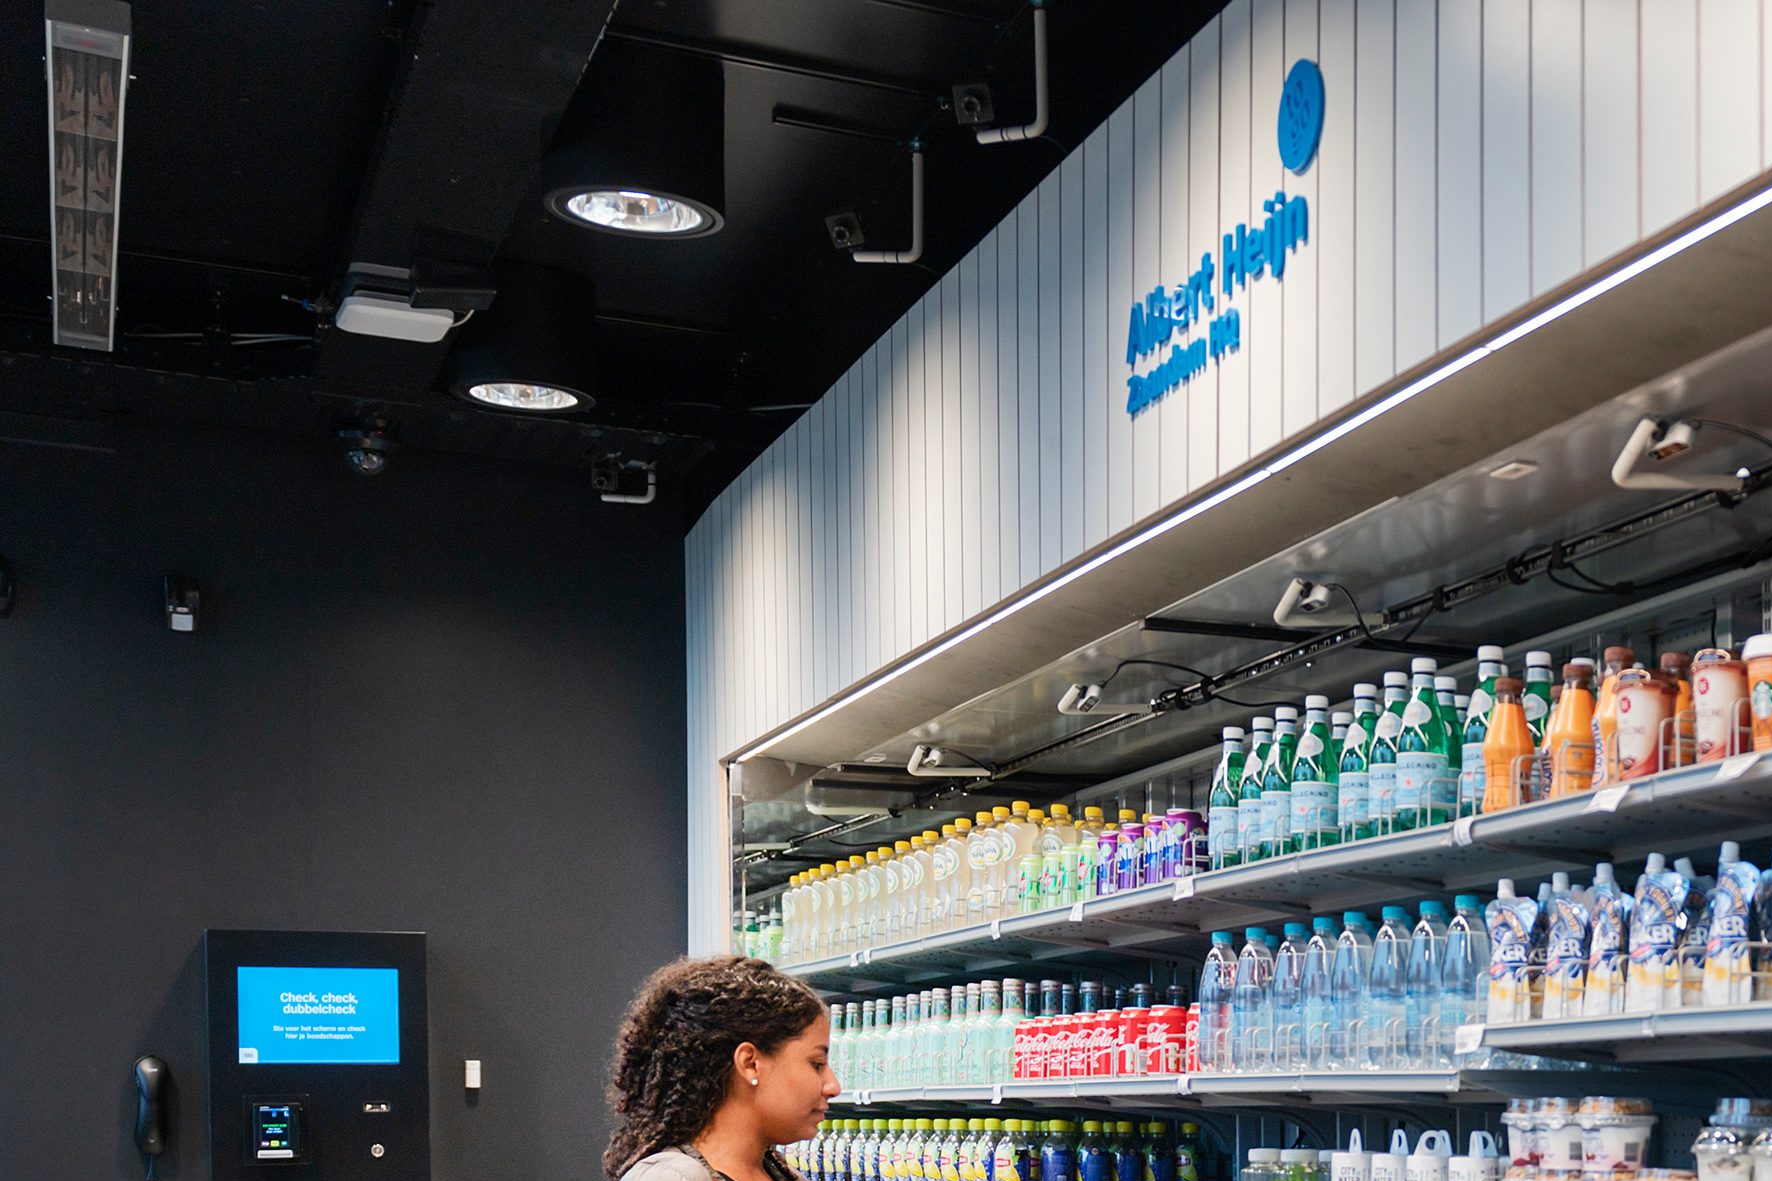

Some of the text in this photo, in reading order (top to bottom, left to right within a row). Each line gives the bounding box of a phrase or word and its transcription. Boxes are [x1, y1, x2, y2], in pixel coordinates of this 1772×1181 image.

[1126, 191, 1309, 365] Albert Heijn
[1127, 308, 1241, 415] Zaandam HQ
[280, 992, 359, 1004] Check, check,
[283, 1003, 356, 1014] dubbelcheck
[1340, 1166, 1356, 1176] CITY
